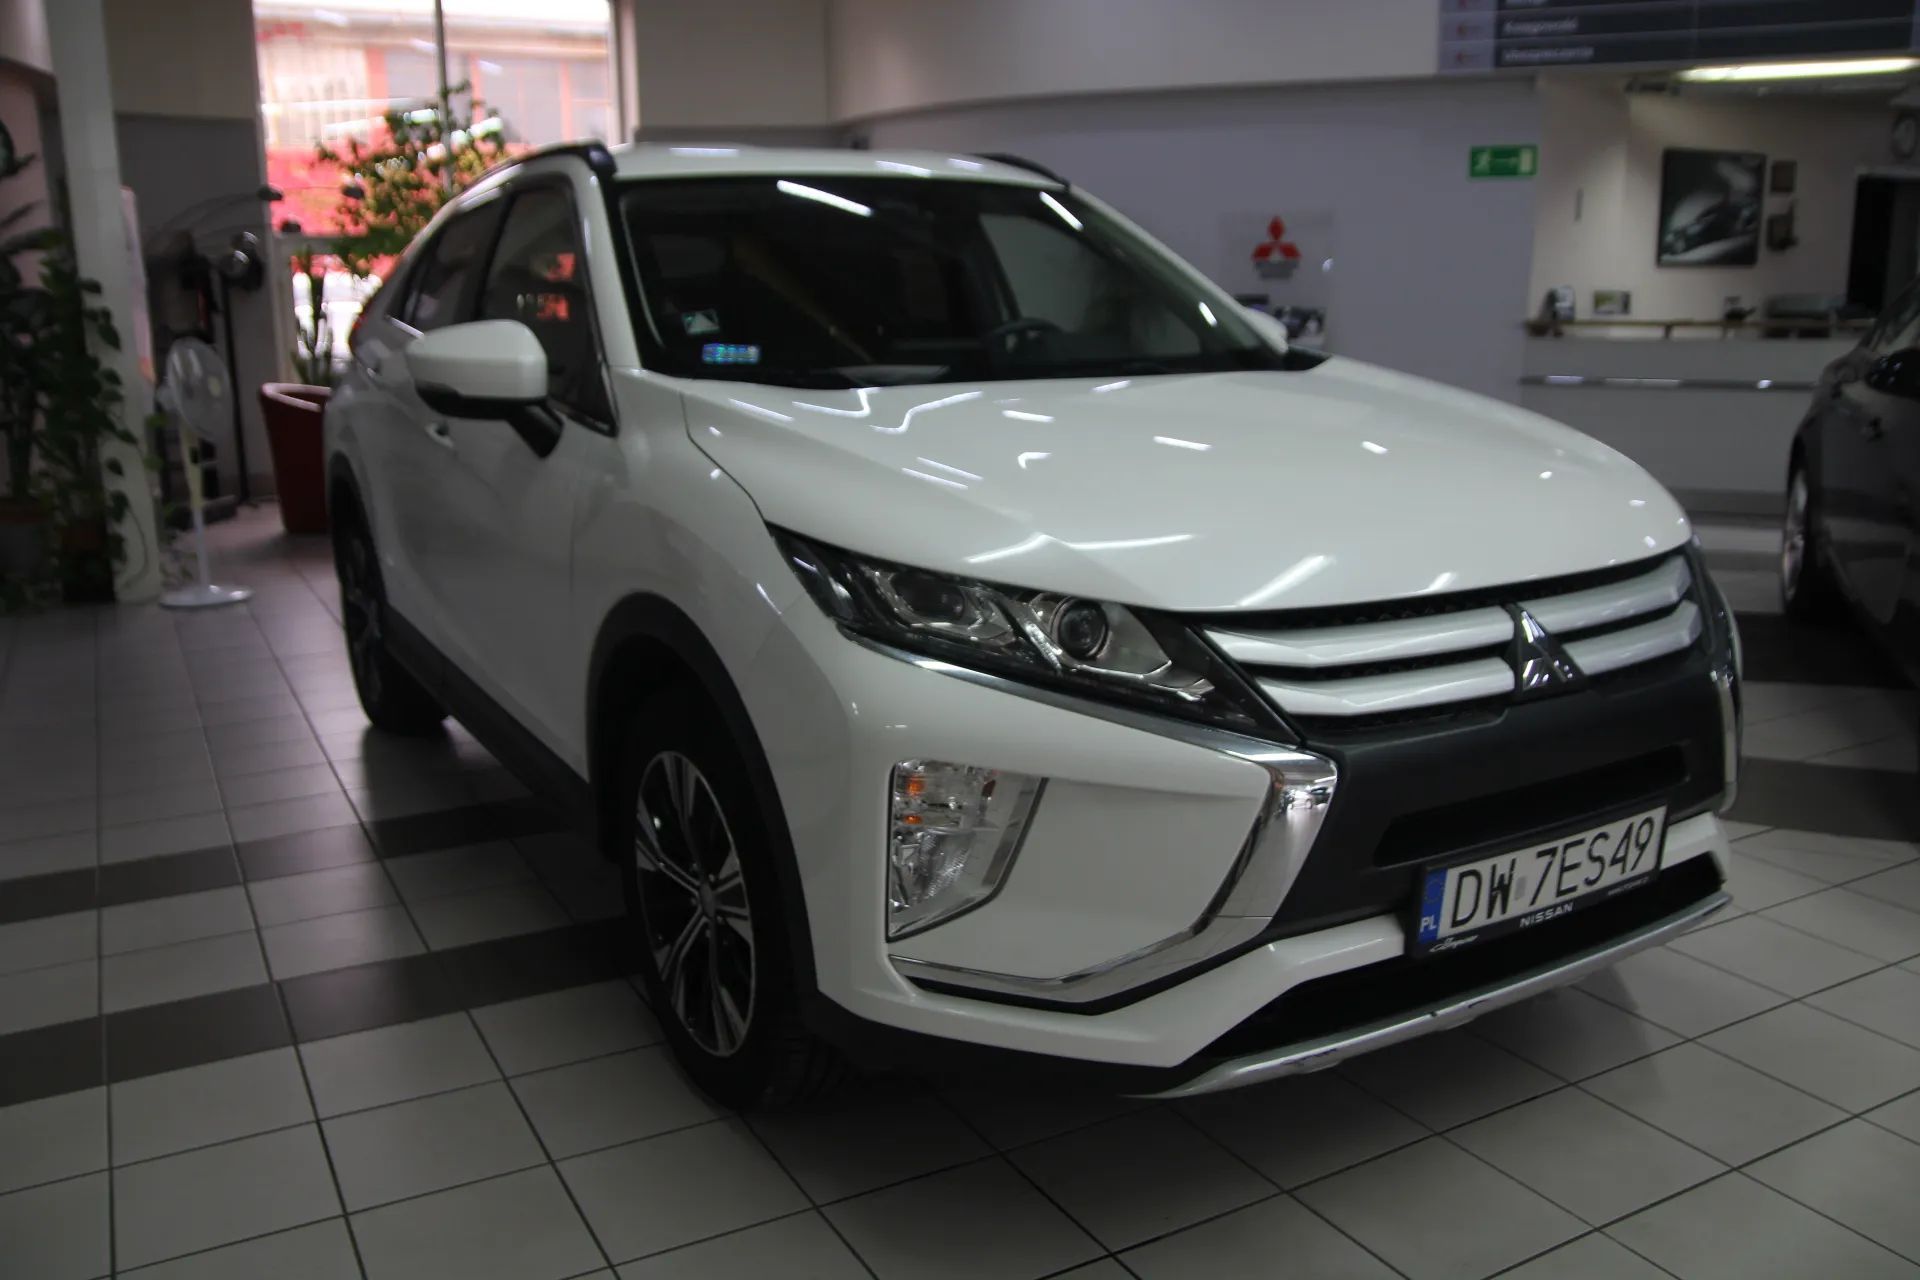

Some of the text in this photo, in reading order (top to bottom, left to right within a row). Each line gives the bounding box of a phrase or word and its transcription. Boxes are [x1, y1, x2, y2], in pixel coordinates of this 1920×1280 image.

[1451, 816, 1655, 928] DW 7ES49
[1420, 915, 1437, 932] PL
[1520, 901, 1574, 928] NISSAN
